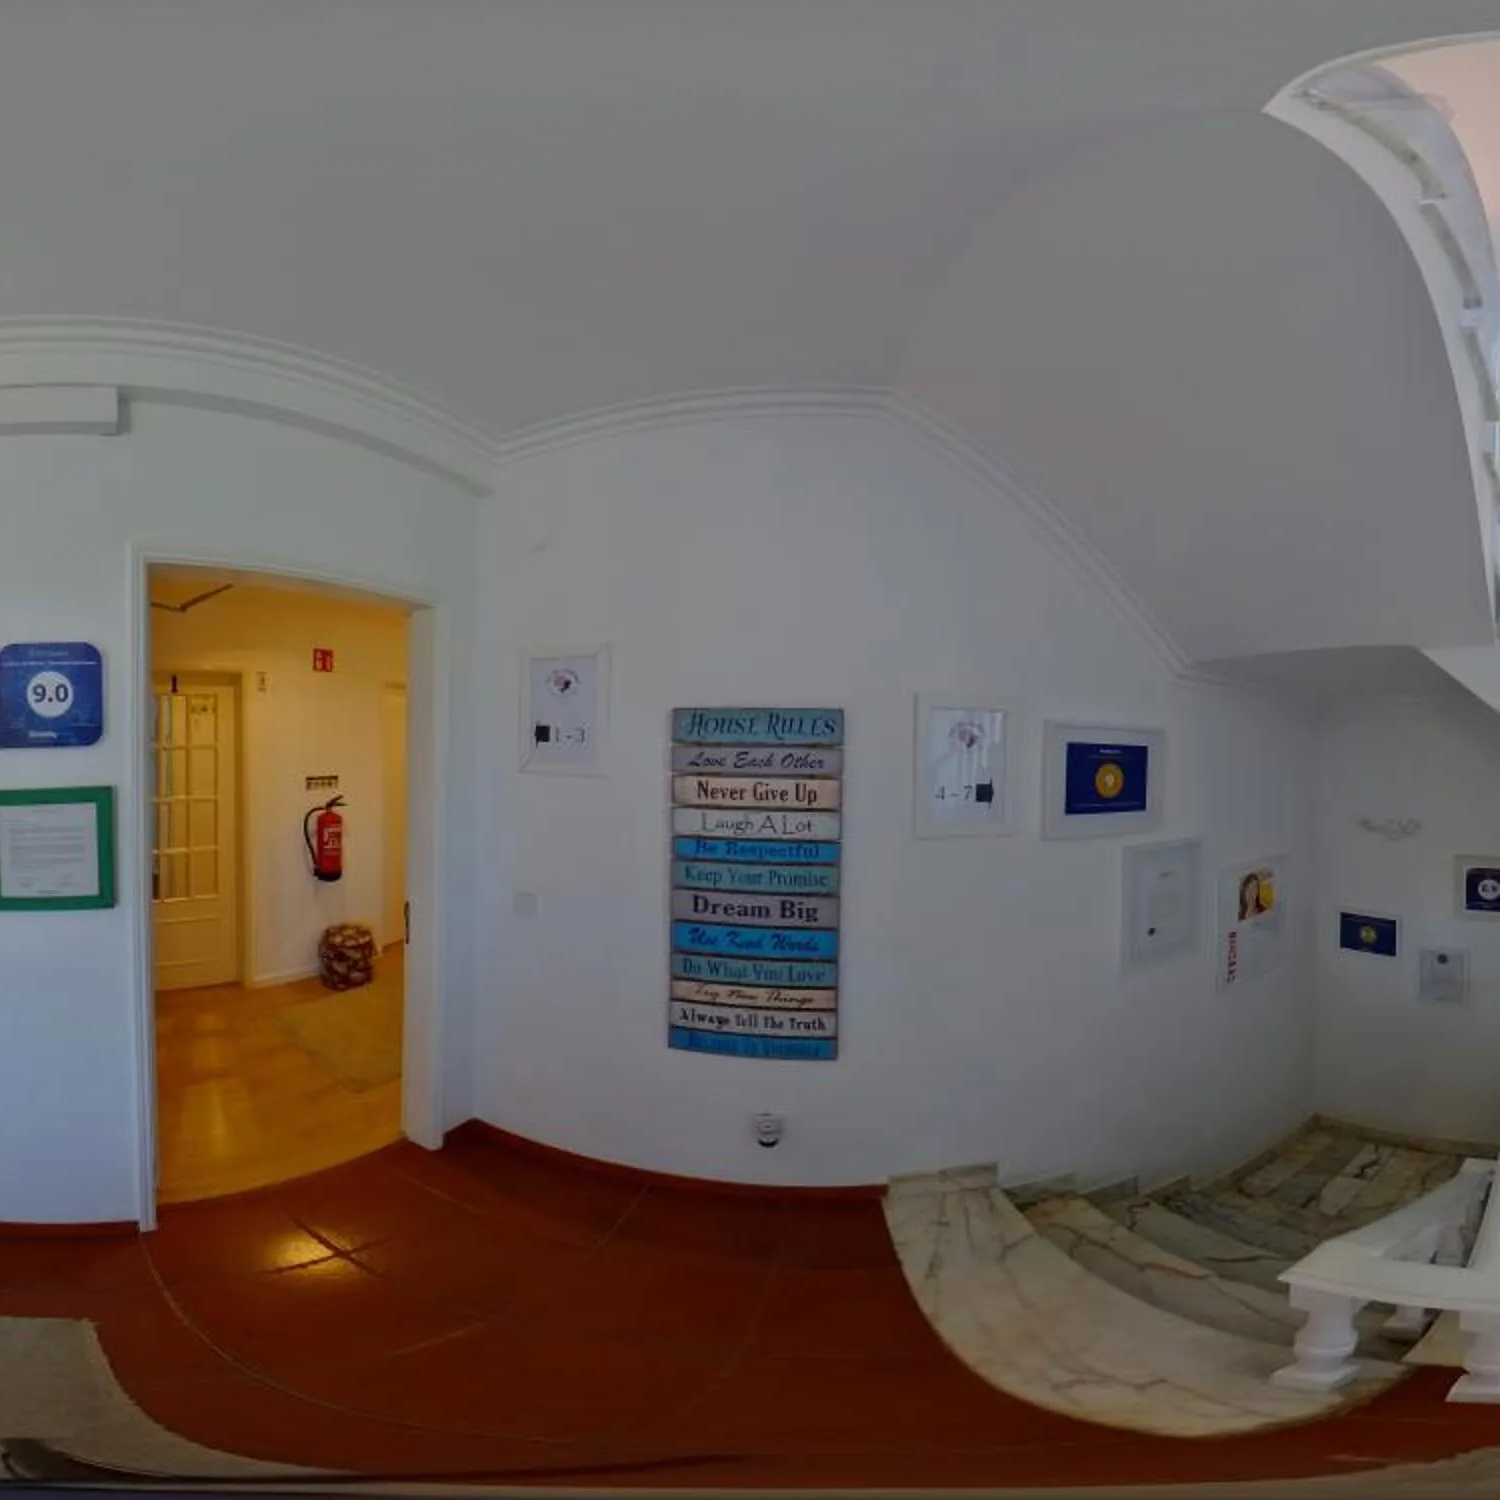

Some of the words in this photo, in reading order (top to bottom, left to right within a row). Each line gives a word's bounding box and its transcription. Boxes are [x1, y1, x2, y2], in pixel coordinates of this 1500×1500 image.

[32, 684, 69, 702] 9.0
[687, 752, 726, 767] Love
[733, 752, 773, 769] Each
[781, 752, 825, 769] Other
[696, 780, 747, 801] Never
[752, 781, 789, 802] Give
[795, 783, 817, 806] Up
[701, 812, 754, 835] Laugh
[758, 815, 778, 833] A
[782, 815, 813, 835] Lot
[684, 865, 723, 887] Keep
[728, 868, 763, 884] Your
[769, 870, 828, 887] Promise
[692, 894, 771, 919] Dream
[778, 900, 820, 923] Big
[682, 958, 705, 975] Do
[708, 959, 748, 978] What
[752, 963, 783, 981] You
[788, 965, 826, 982] Love
[680, 1008, 730, 1029] Always
[735, 1013, 758, 1028] Tell
[788, 1016, 826, 1031] Truth
